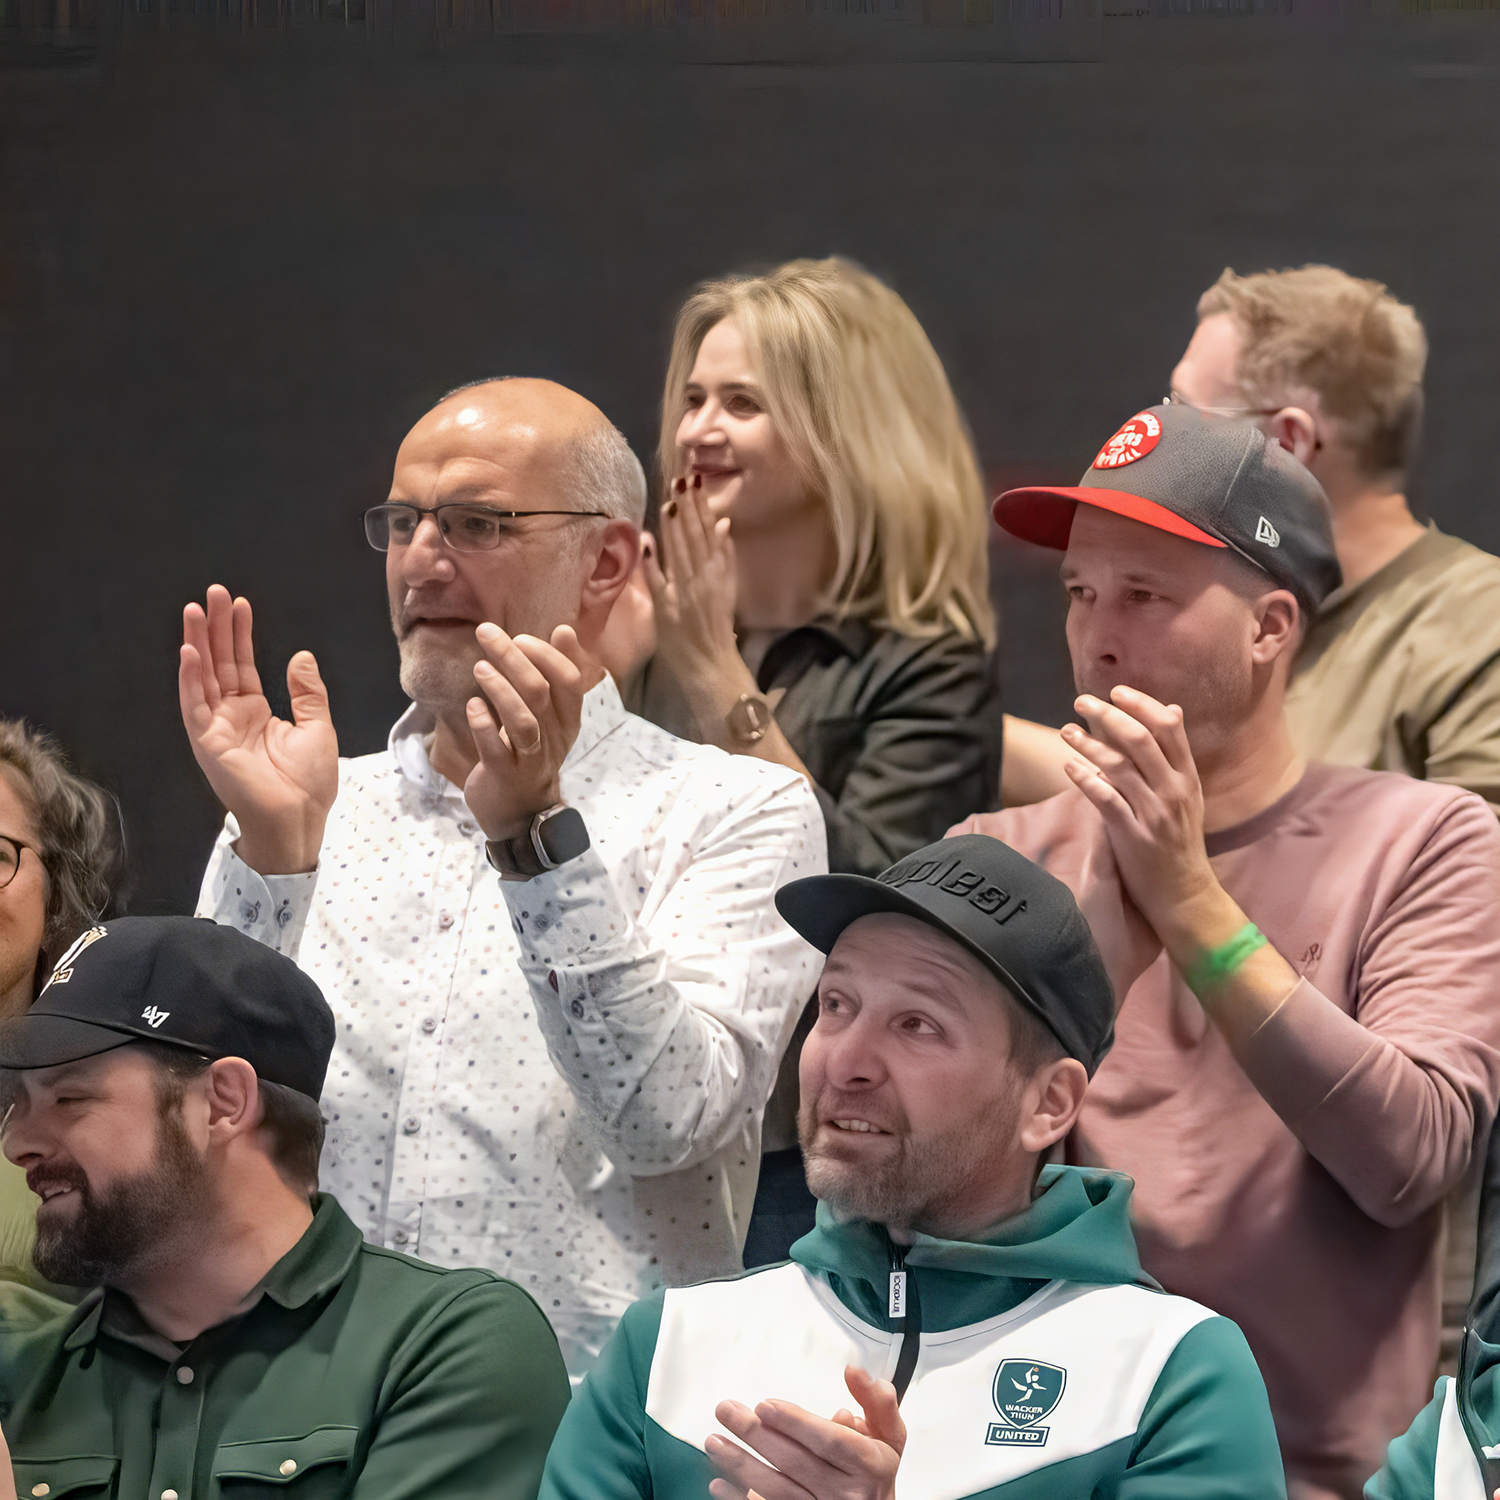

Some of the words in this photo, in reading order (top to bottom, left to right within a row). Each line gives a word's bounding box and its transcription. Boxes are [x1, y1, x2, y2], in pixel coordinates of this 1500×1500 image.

[141, 1005, 171, 1028] 47
[1005, 1404, 1043, 1414] WACKER
[1010, 1412, 1035, 1420] THUN
[995, 1430, 1040, 1441] UNITED
